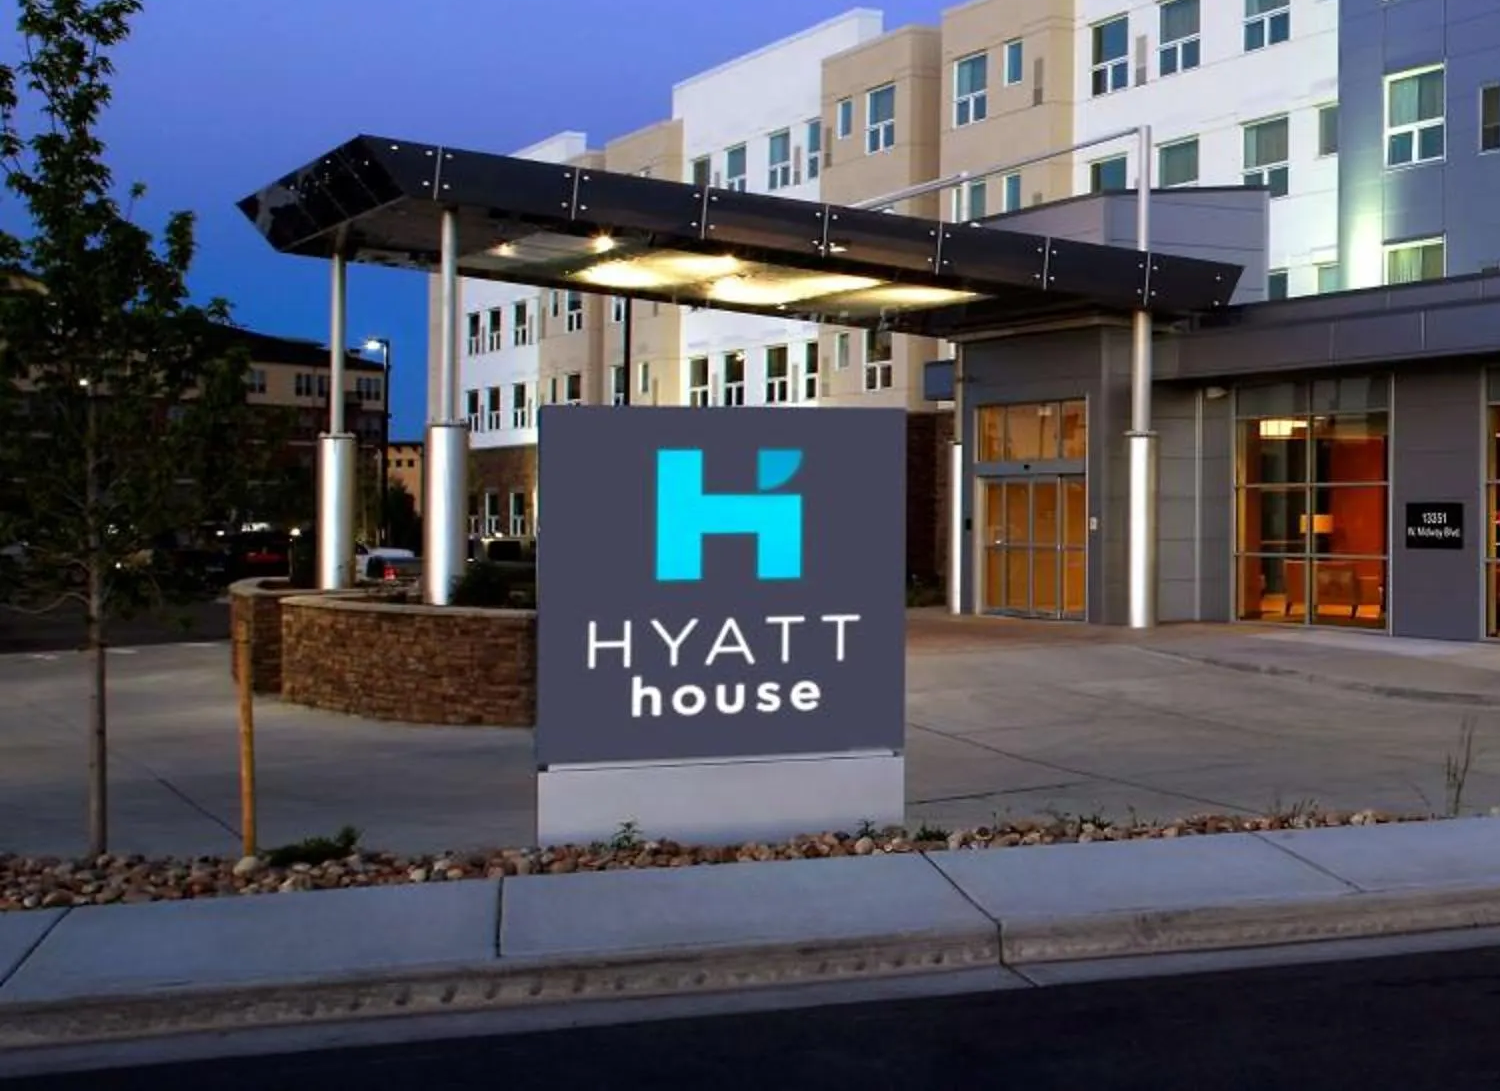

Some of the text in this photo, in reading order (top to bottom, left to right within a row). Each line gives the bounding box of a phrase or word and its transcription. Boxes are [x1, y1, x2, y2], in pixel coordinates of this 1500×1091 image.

[1422, 512, 1447, 524] 13351
[586, 614, 861, 670] HYATT
[630, 675, 822, 718] house
